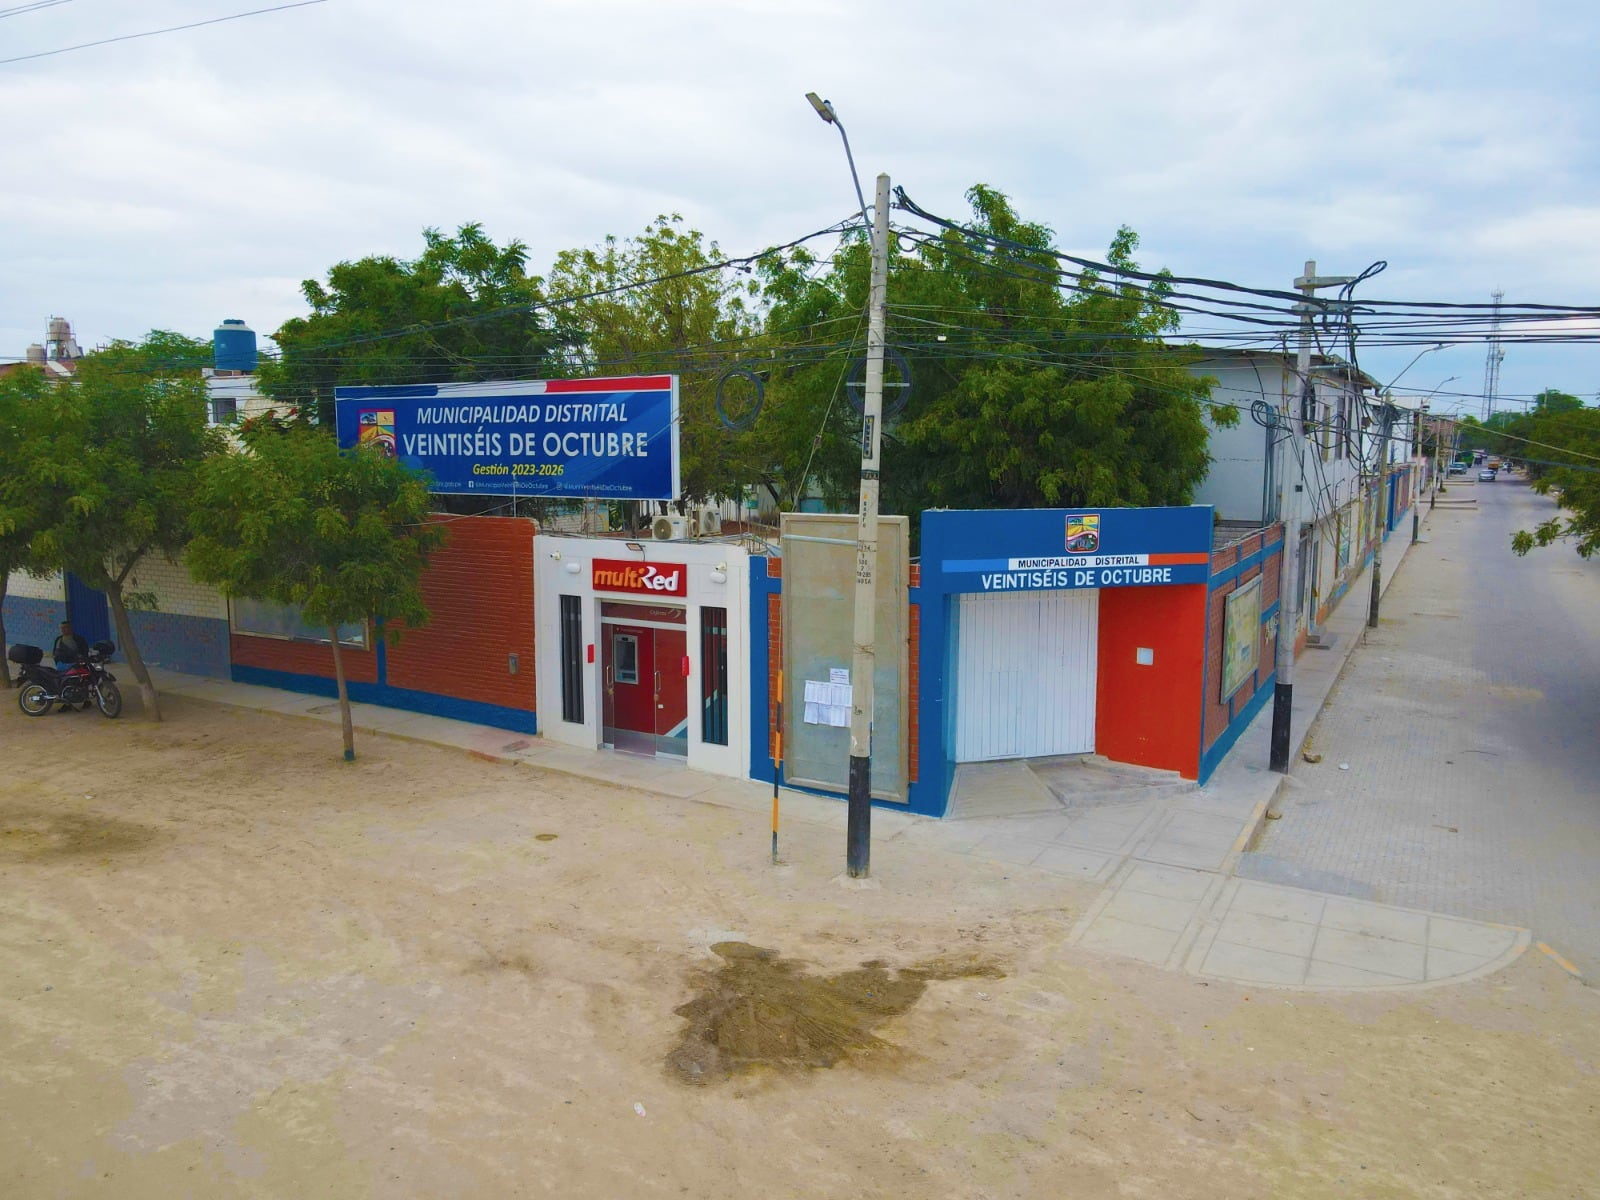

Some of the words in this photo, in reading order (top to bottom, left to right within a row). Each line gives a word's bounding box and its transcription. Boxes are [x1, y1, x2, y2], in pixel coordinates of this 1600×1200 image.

[417, 405, 540, 424] MUNICIPALIDAD
[545, 403, 628, 423] DISTRITAL
[402, 425, 503, 456] VEINTISÉIS
[509, 432, 536, 456] DE
[542, 432, 648, 457] OCTUBRE
[472, 463, 509, 475] Gestión
[511, 463, 565, 476] 2023-2026
[1018, 558, 1087, 568] MUNICIPALIDAD
[1095, 556, 1140, 566] DISTRITAL
[594, 566, 679, 591] multiRed
[981, 569, 1068, 590] VEINTISÉIS
[1074, 570, 1096, 586] DE
[1101, 567, 1172, 585] OCTUBRE
